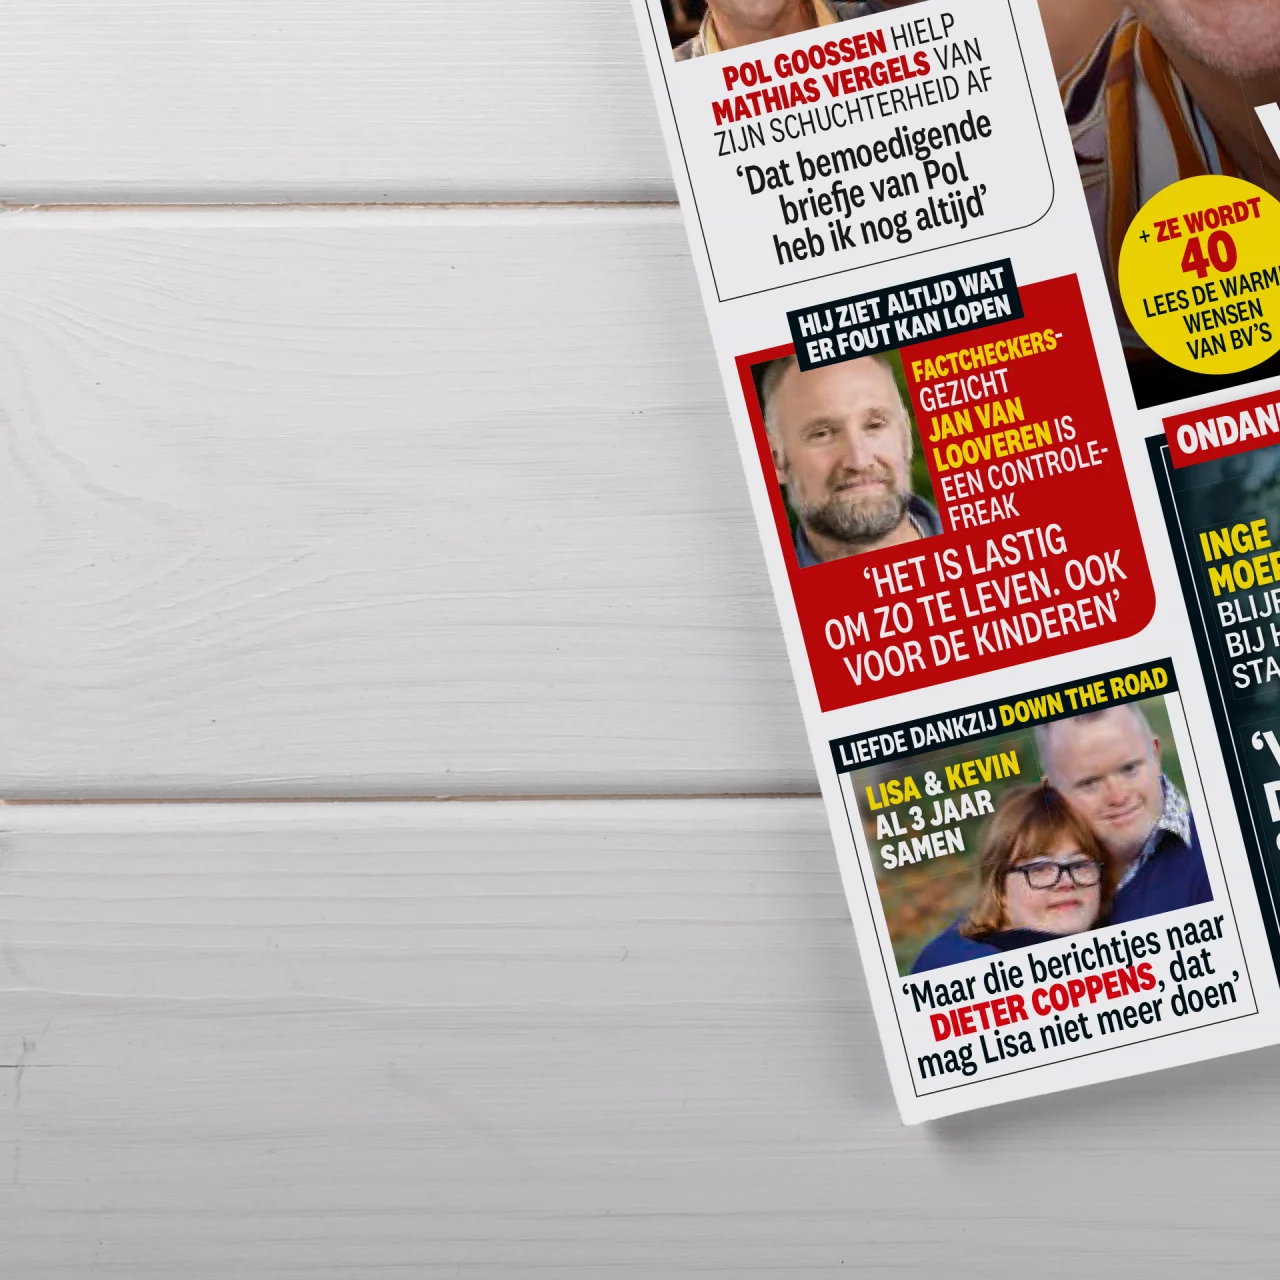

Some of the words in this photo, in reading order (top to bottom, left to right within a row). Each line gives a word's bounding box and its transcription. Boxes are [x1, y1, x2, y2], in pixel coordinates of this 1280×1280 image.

[711, 77, 821, 126] MATHIAS
[821, 50, 931, 98] VERGELS
[932, 37, 983, 71] VAN
[721, 59, 773, 92] POL
[773, 28, 887, 79] GOOSSEN
[890, 12, 955, 51] HIELP
[713, 121, 766, 157] ZIJN
[769, 75, 960, 143] SCHUCHTERHEID
[968, 65, 992, 96] AF
[736, 159, 795, 195] ‘Dat
[795, 109, 993, 182] bemoedigende
[778, 179, 866, 226] briefje
[869, 171, 920, 203] van
[922, 150, 969, 190] Pol
[1153, 216, 1182, 243] ZE
[1182, 196, 1261, 235] WORDT
[1180, 229, 1238, 279] 40
[798, 309, 834, 337] HIJ
[835, 297, 880, 328] ZIET
[888, 279, 957, 316] ALTIJD
[957, 267, 1004, 297] WAT
[1142, 289, 1190, 318] LEES
[1191, 281, 1219, 306] DE
[1182, 297, 1264, 334] WENSEN
[911, 329, 1063, 383] FACTCHECKERS-
[919, 367, 1008, 412] GEZICHT
[929, 408, 973, 442] JAN
[974, 396, 1025, 429] VAN
[933, 421, 1053, 472] LOOVEREN
[1054, 415, 1076, 442] IS
[940, 469, 984, 502] EEN
[987, 440, 1108, 490] CONTROLE-
[947, 492, 1020, 531] FREAK
[1199, 518, 1272, 562] INGE
[863, 555, 926, 598] ‘HET
[933, 548, 963, 582] IS
[965, 523, 1068, 575] LASTIG
[843, 640, 926, 686] VOOR
[929, 629, 970, 666] DE
[972, 588, 1120, 656] KINDEREN’
[1225, 626, 1265, 658] BIJ
[839, 730, 908, 766] LIEFDE
[910, 708, 997, 749] DANKZIJ
[999, 692, 1064, 727] DOWN
[1064, 680, 1108, 710] THE
[1109, 667, 1168, 699] ROAD
[865, 776, 922, 811] LISA
[924, 771, 944, 796] &
[945, 750, 1021, 791] KEVIN
[880, 827, 965, 870] SAMEN
[902, 976, 976, 1013] ‘Maar
[983, 960, 1024, 995] die
[1027, 930, 1161, 984] berichtjes
[1166, 914, 1224, 951] naar
[929, 993, 1029, 1043] DIETER
[1031, 961, 1167, 1017] COPPENS,
[1169, 947, 1216, 983] dat
